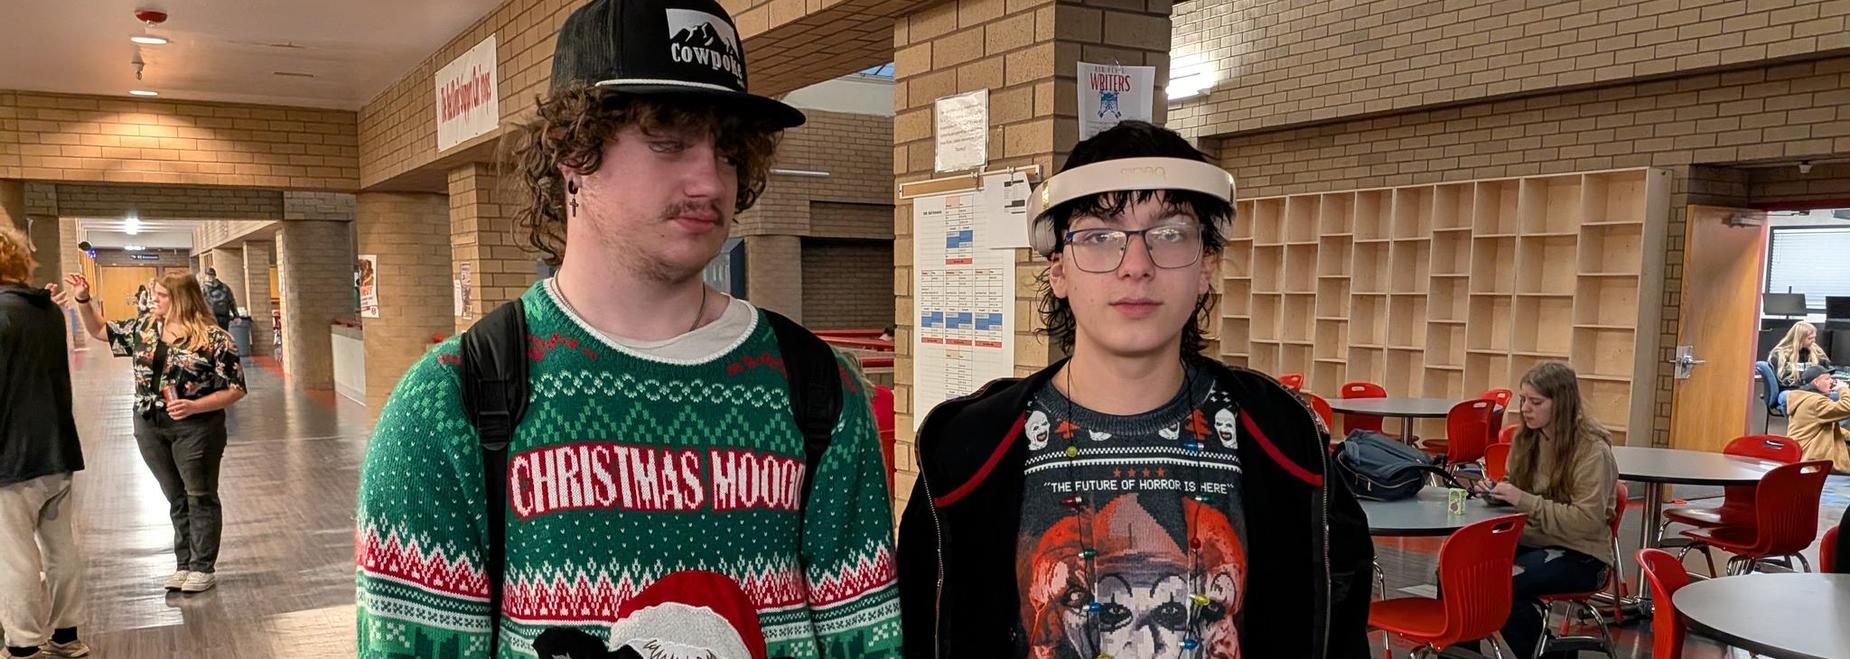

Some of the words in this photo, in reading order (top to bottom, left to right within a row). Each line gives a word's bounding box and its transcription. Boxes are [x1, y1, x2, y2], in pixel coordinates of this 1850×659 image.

[1089, 72, 1131, 92] WRITERS
[511, 446, 704, 516] CHRISTMAS
[1075, 480, 1118, 492] FUTURE
[1121, 479, 1136, 490] OF
[1139, 479, 1182, 491] HORROR
[1184, 481, 1196, 492] IS
